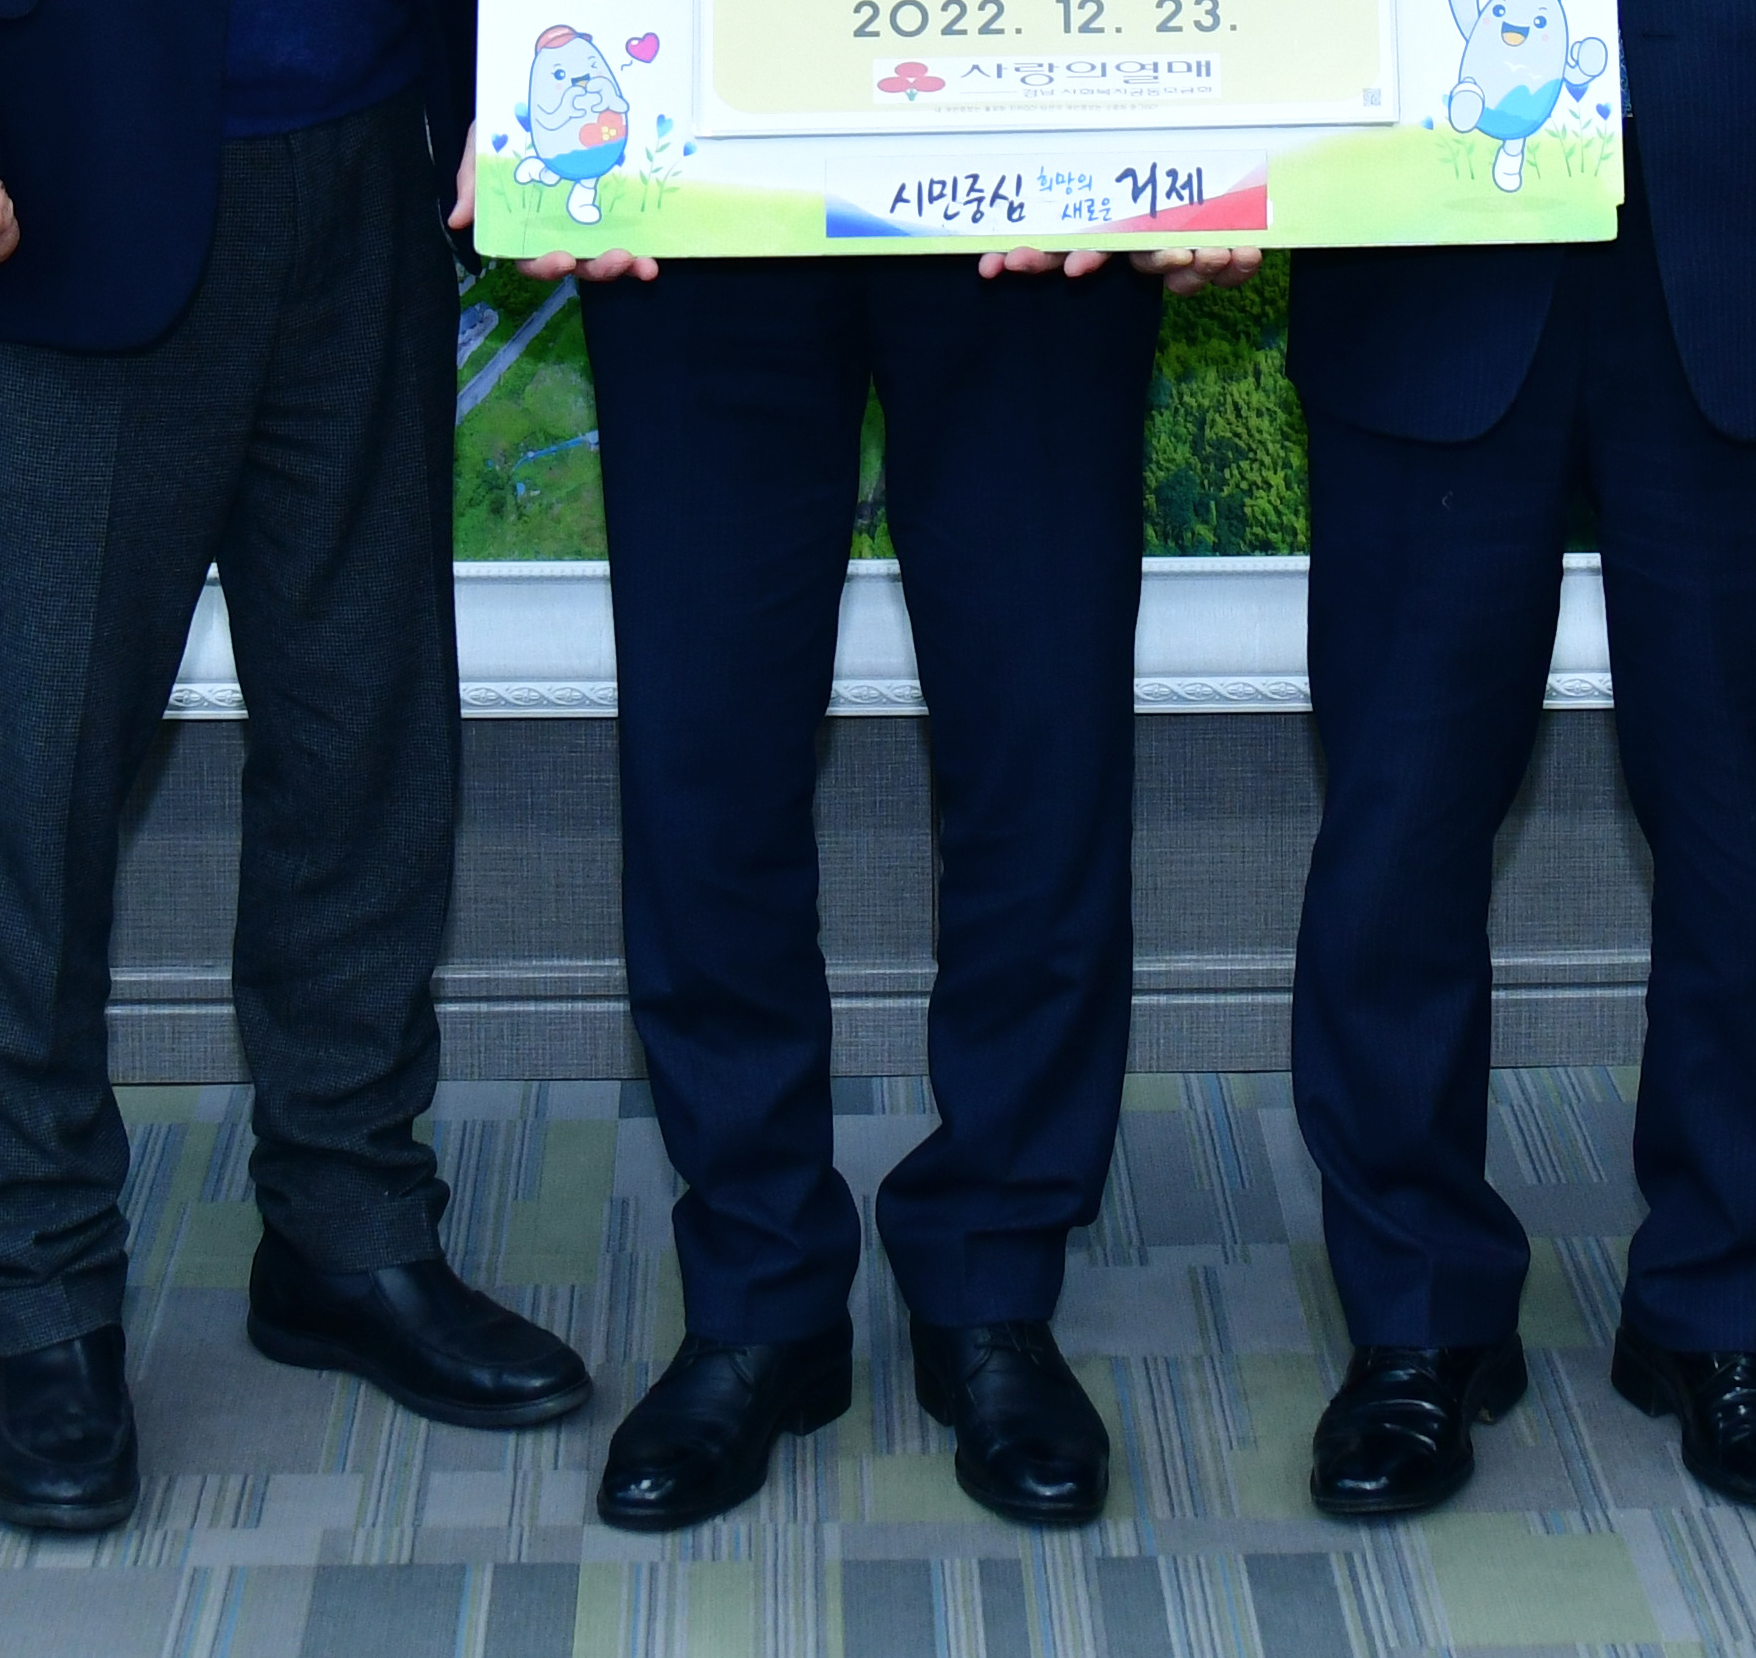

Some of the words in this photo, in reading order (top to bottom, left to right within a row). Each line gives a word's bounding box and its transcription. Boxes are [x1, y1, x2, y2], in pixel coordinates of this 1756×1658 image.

[961, 60, 1211, 86] 사랑의열매
[1037, 166, 1092, 193] 희망의
[1115, 162, 1204, 219] 거제
[889, 173, 1026, 224] 시민중심
[1061, 198, 1112, 221] 새로운
